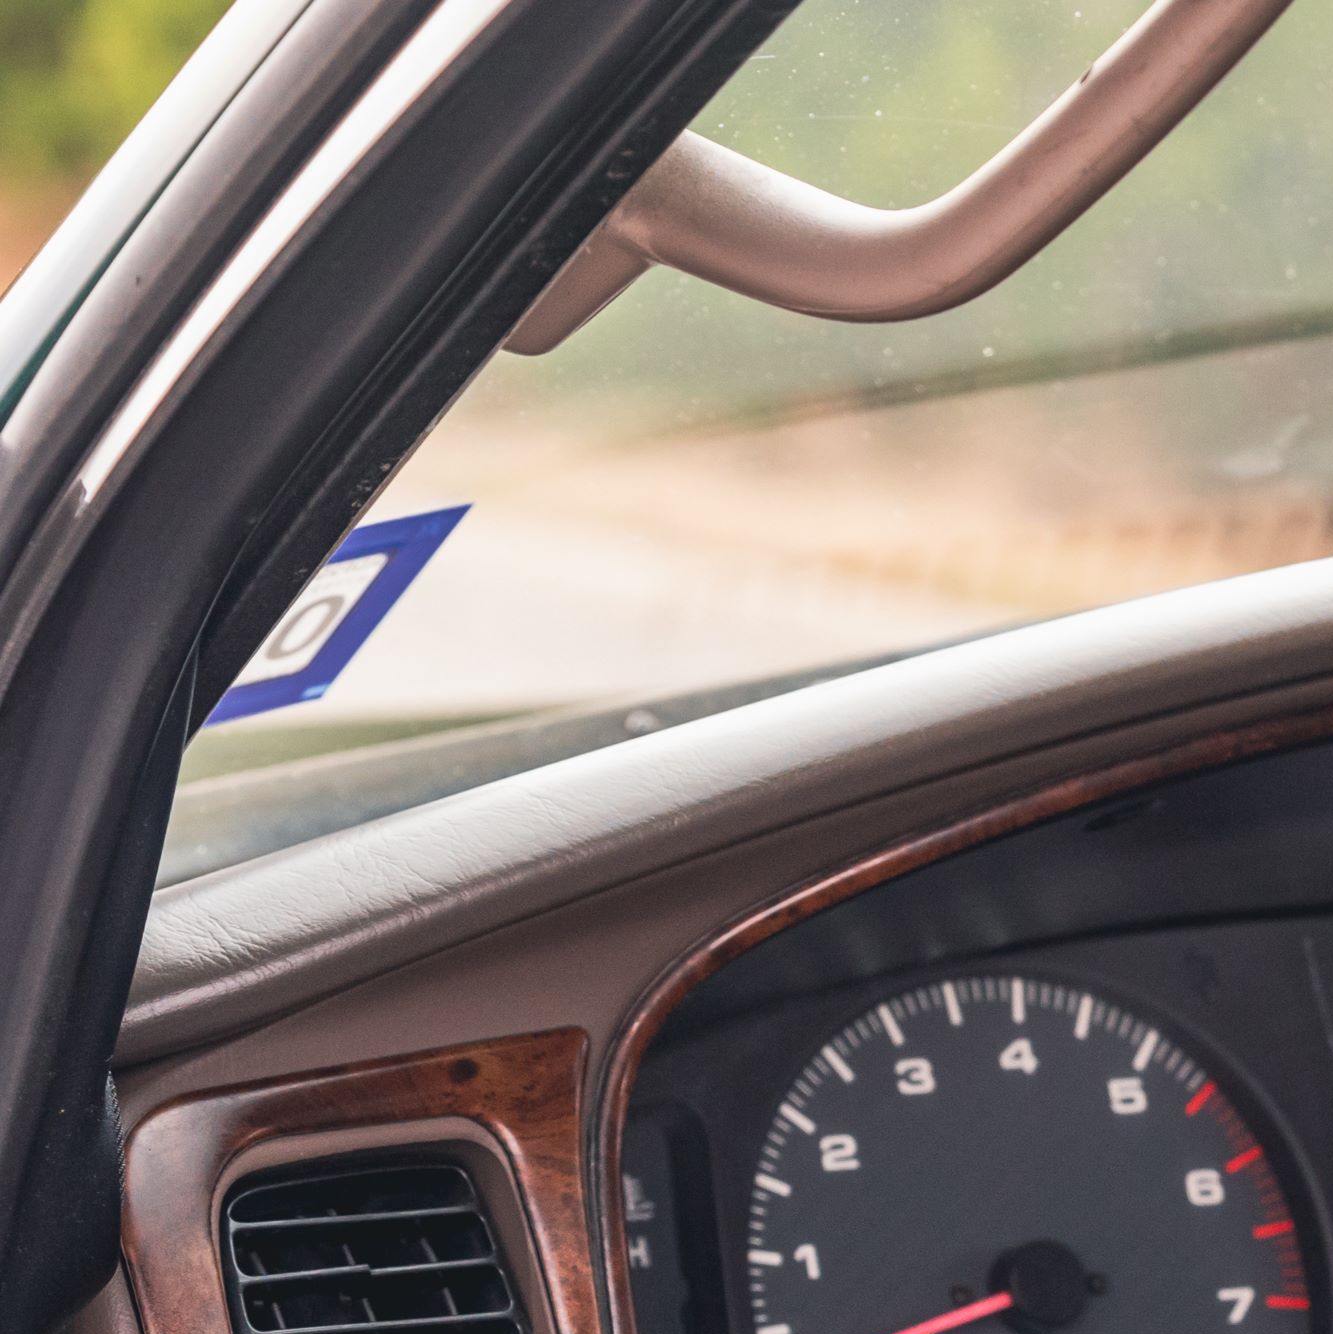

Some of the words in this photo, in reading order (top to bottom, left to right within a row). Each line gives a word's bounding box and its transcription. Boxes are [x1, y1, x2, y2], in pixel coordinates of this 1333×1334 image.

[999, 1037, 1039, 1075] 4
[895, 1057, 937, 1096] 3
[1107, 1076, 1148, 1116] 5
[818, 1133, 862, 1172] 2
[1184, 1167, 1226, 1207] 6
[793, 1243, 822, 1281] 1
[1216, 1285, 1256, 1325] 7
